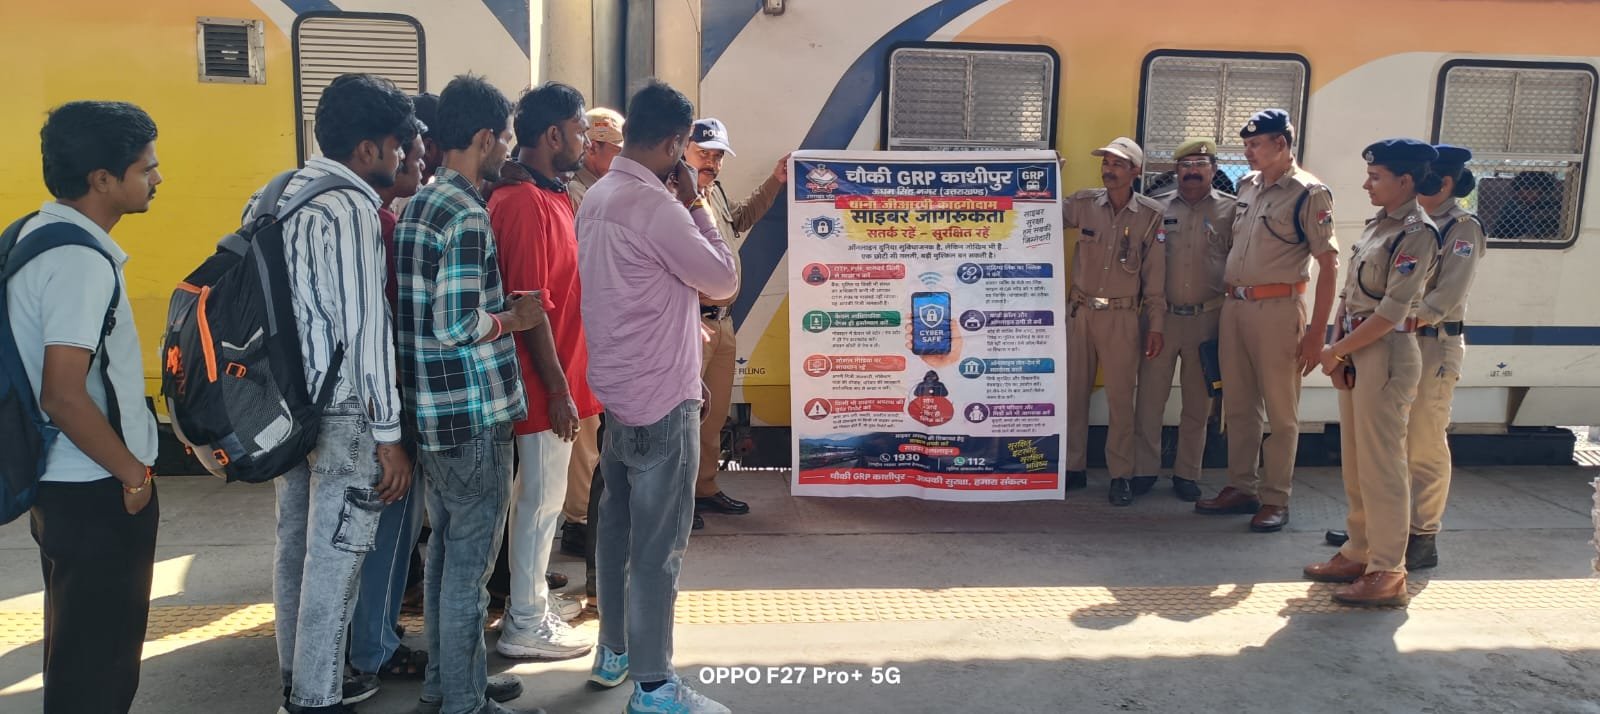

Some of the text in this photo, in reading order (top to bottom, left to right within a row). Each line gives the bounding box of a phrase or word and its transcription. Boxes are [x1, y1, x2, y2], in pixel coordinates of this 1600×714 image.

[845, 165, 1013, 191] चौकी GRP काशीपुर
[1022, 171, 1044, 180] GRP
[850, 209, 910, 226] साइबर
[866, 226, 898, 239] सतर्क
[901, 225, 917, 239] रहें
[931, 226, 972, 241] सुरक्षित
[975, 226, 991, 239] रहें
[738, 367, 766, 375] FILLING
[893, 453, 920, 462] 1930
[968, 457, 986, 466] 112
[853, 472, 871, 480] GRP
